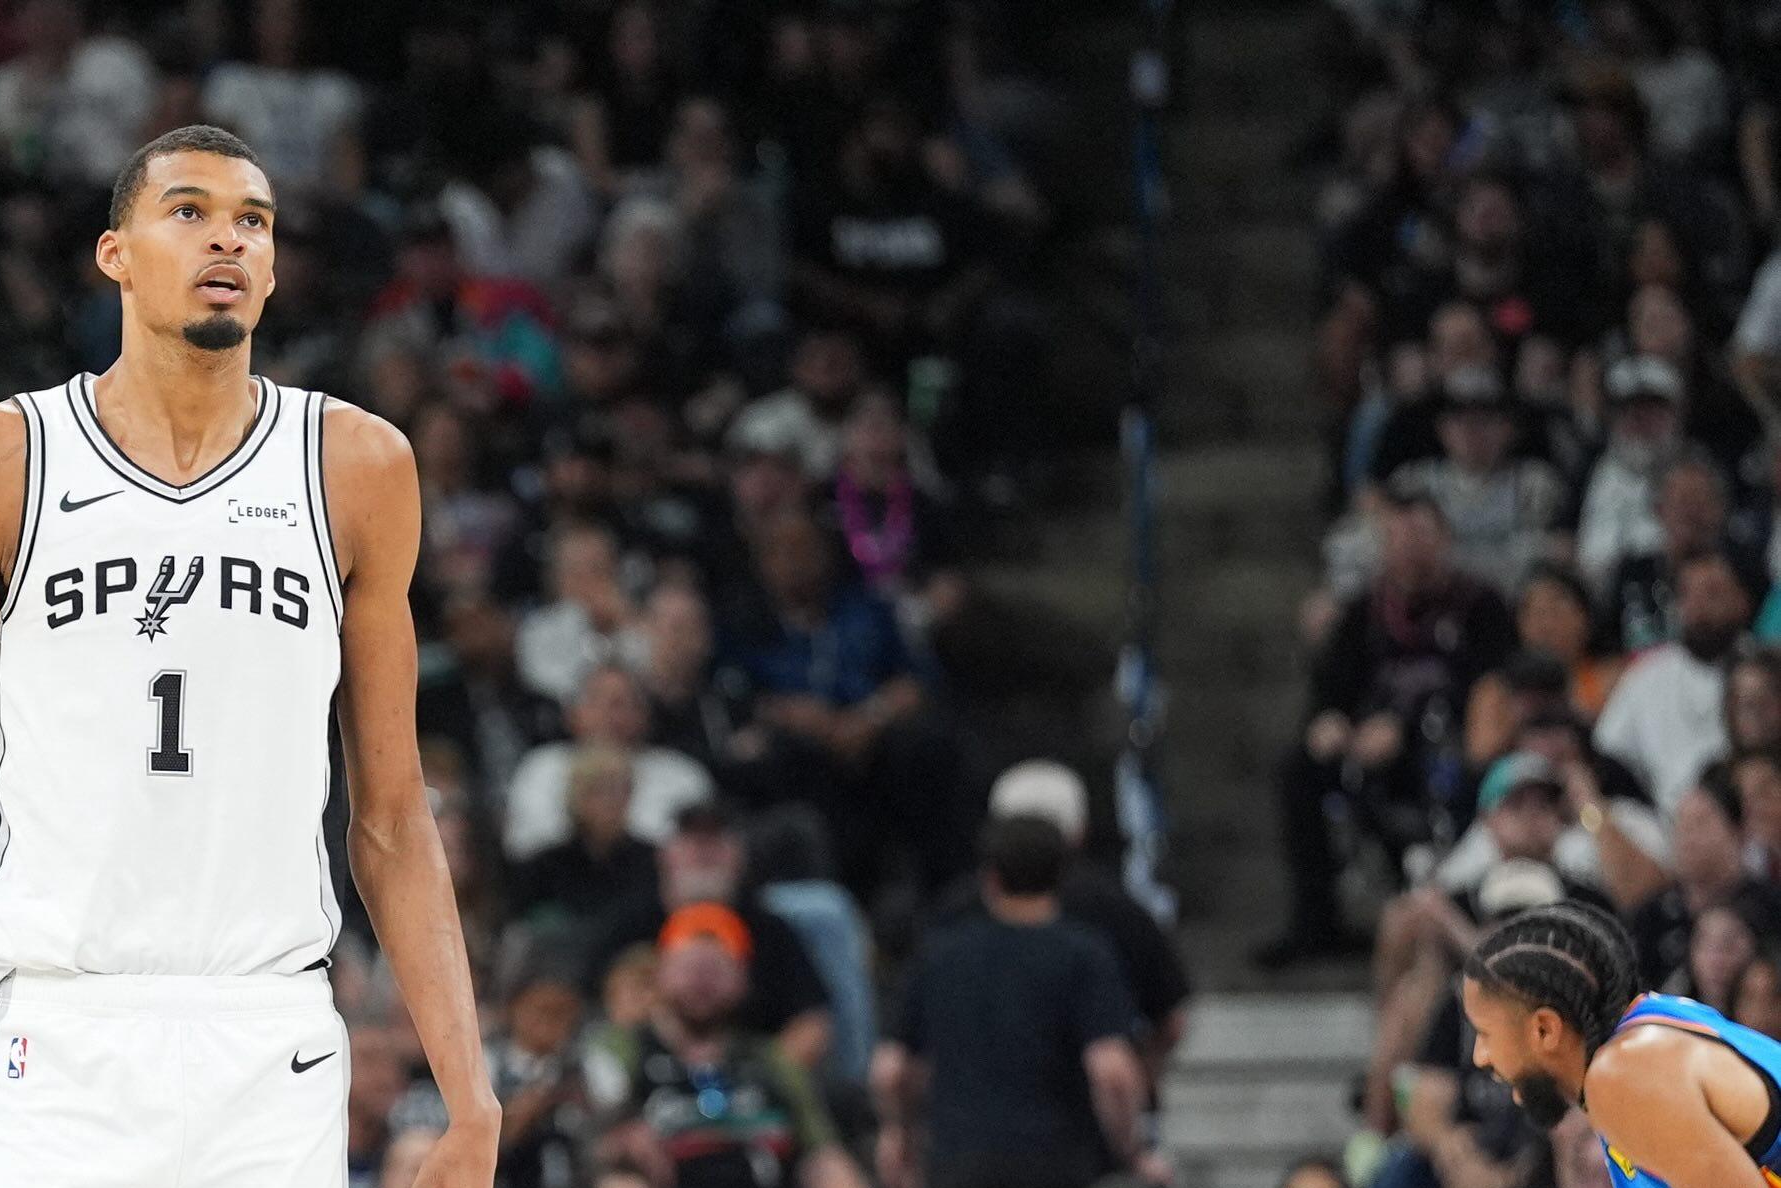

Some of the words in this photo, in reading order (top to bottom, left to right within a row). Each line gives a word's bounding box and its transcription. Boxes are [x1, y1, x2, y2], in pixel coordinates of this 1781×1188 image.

[237, 506, 288, 519] LEDGER
[45, 555, 310, 643] SPURS
[146, 669, 193, 777] 1
